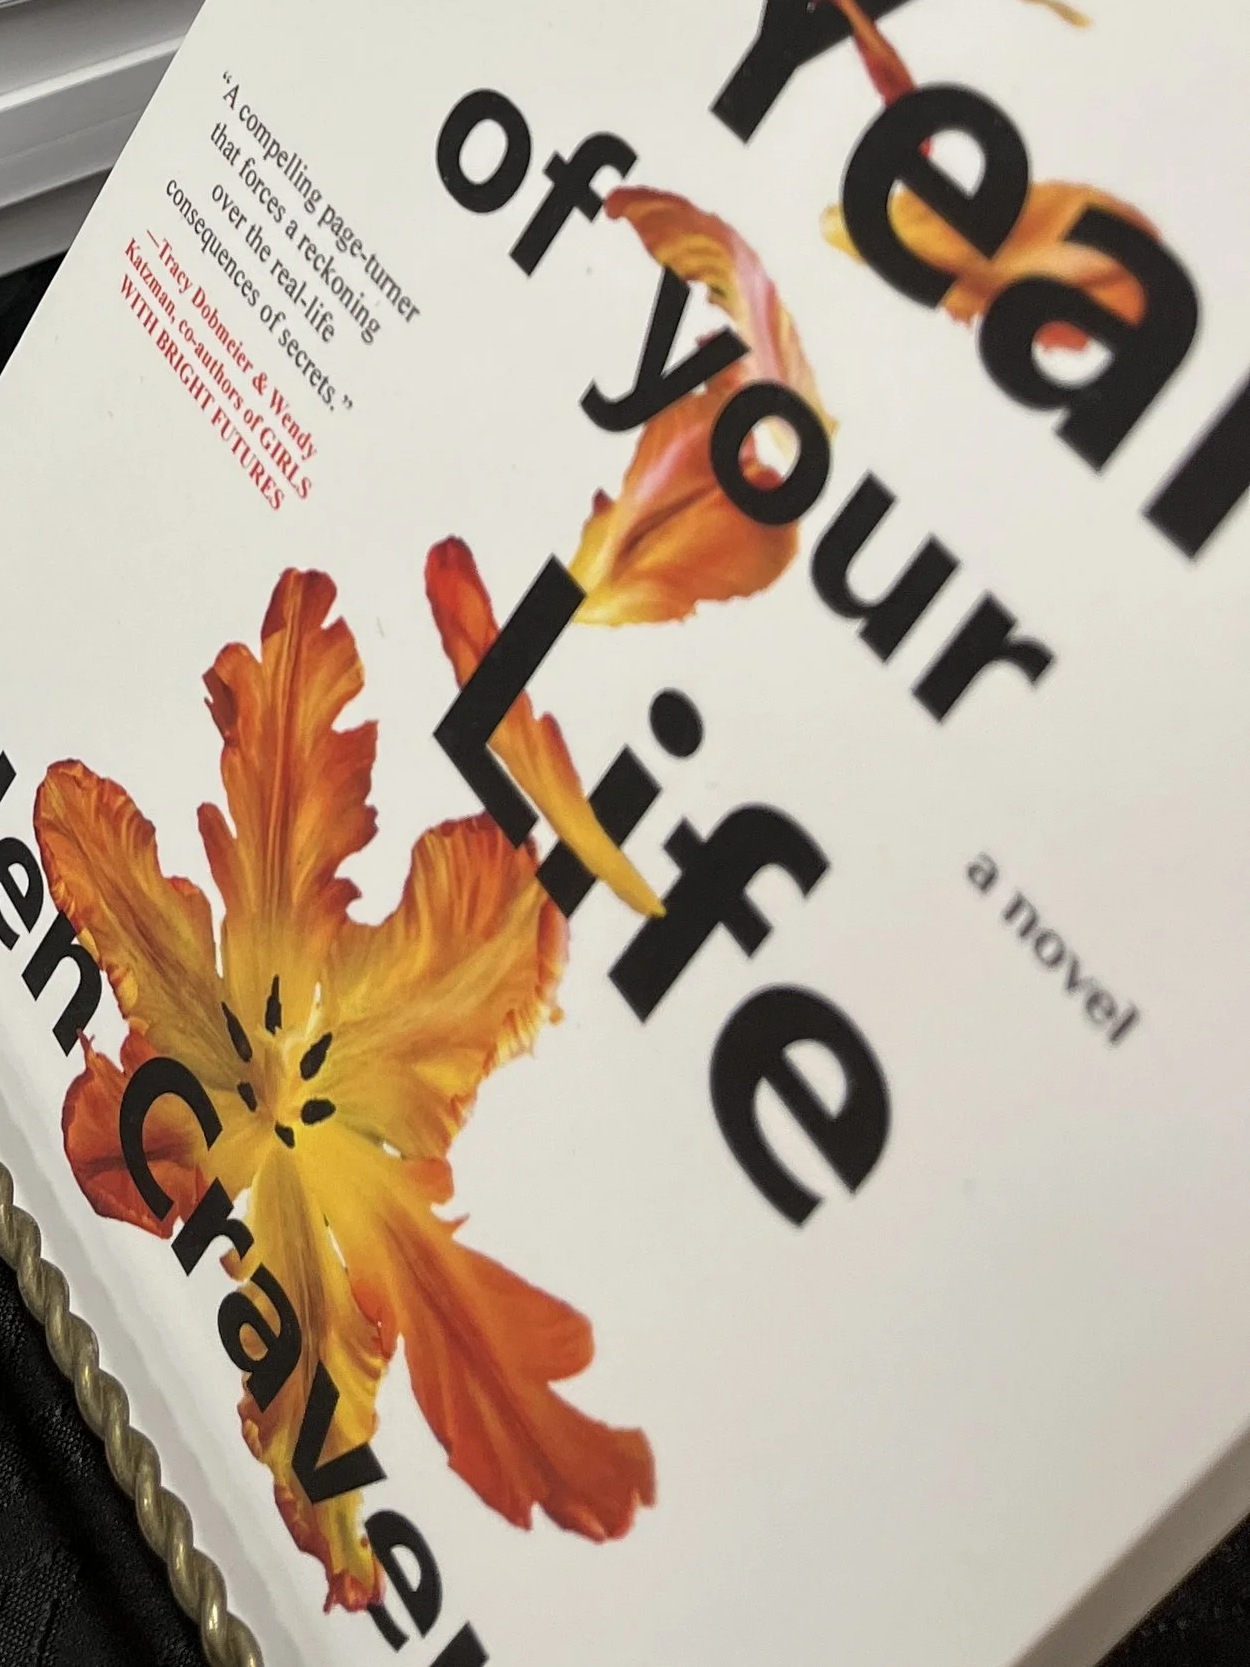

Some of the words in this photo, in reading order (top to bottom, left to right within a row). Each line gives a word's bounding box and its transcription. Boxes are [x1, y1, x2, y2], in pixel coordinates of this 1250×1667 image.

[164, 178, 262, 308] consequences
[259, 303, 288, 334] of
[209, 121, 242, 168] that
[236, 150, 287, 224] forces
[284, 218, 299, 241] a
[296, 233, 382, 345] reckoning
[210, 182, 249, 230] over
[244, 221, 272, 264] the
[269, 258, 336, 344] real-life
[237, 103, 323, 215] compelling
[319, 203, 421, 324] page-turner
[119, 274, 162, 337] WITH
[155, 328, 216, 412] BRIGHT
[209, 405, 285, 512] FUTURES
[124, 237, 177, 324] Katzman,
[177, 318, 245, 413] co-authors
[242, 408, 267, 433] of
[258, 425, 313, 501] GIRLS
[190, 286, 254, 374] Dobmeier
[251, 371, 269, 397] &
[268, 387, 317, 461] Wendy
[436, 88, 639, 278] of
[579, 263, 1056, 724] your
[432, 553, 893, 1229] Life
[963, 850, 1002, 898] a
[999, 888, 1144, 1048] novel
